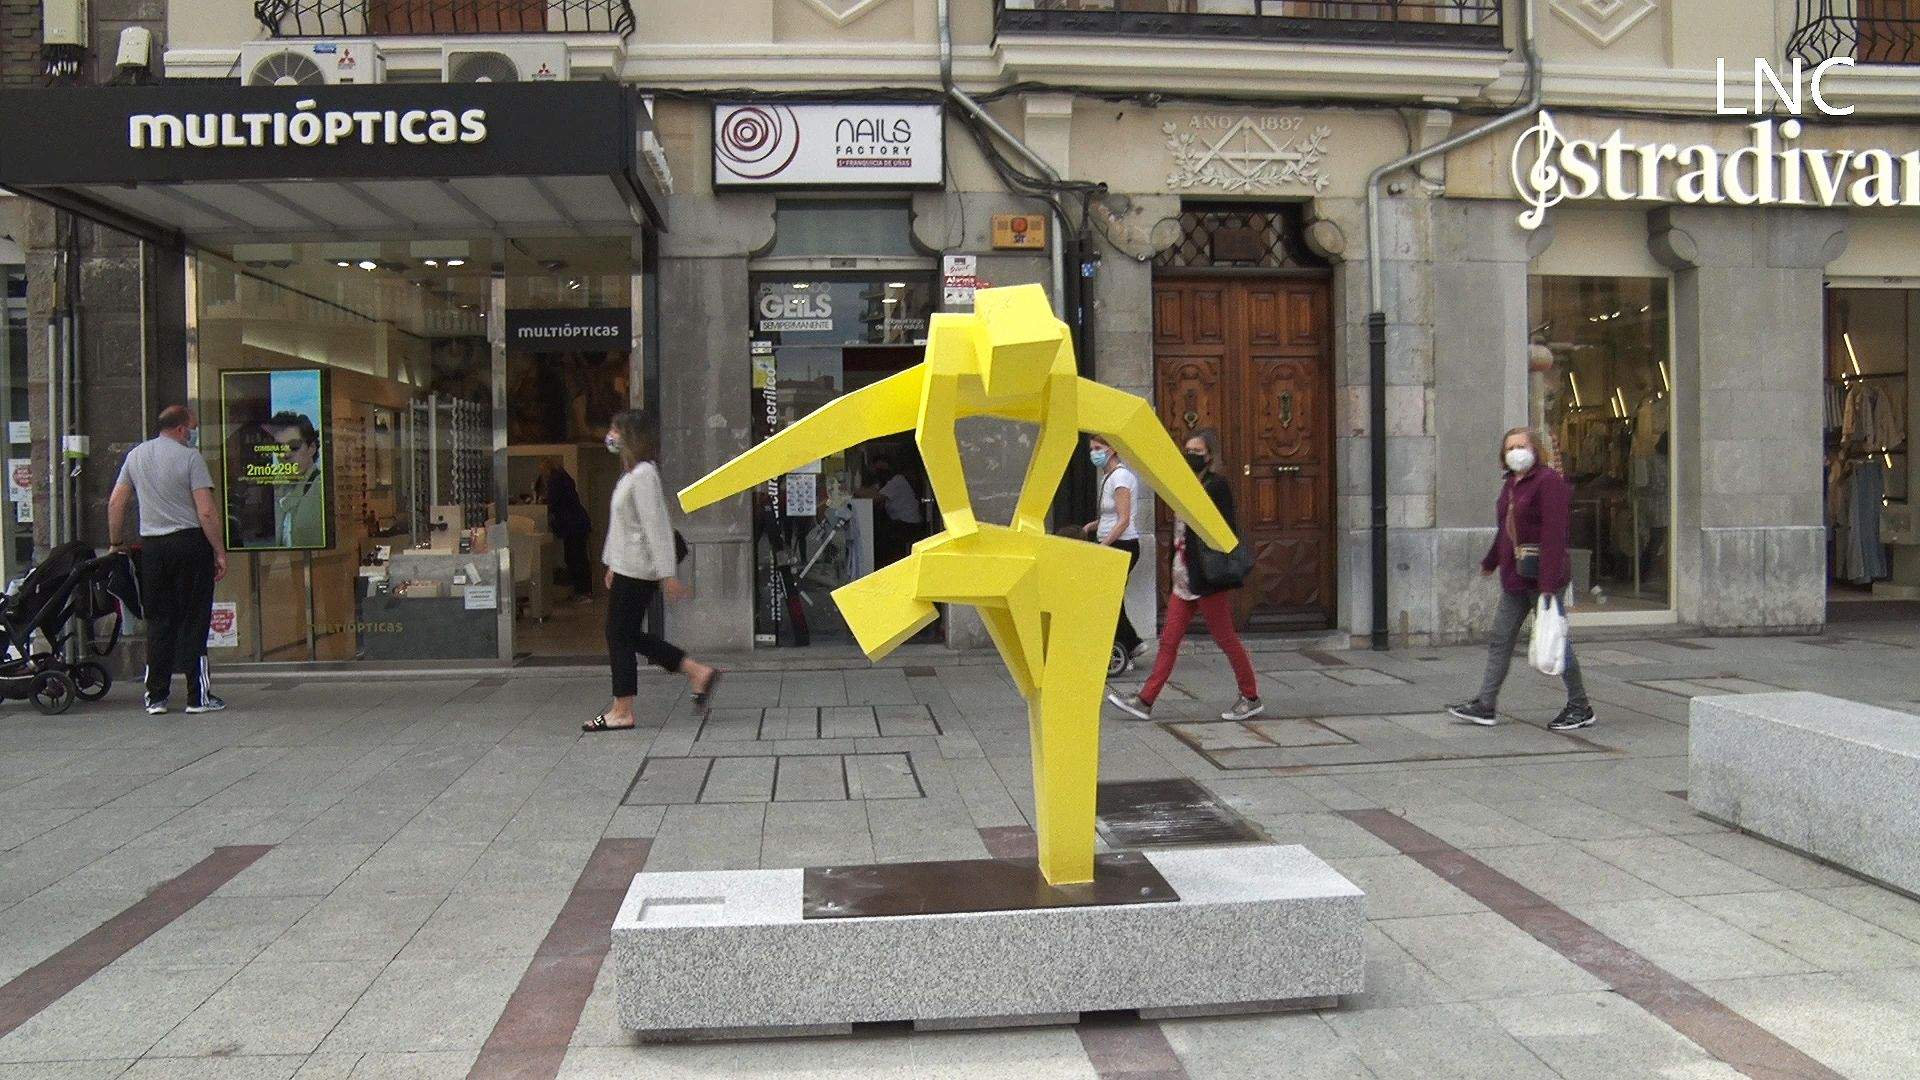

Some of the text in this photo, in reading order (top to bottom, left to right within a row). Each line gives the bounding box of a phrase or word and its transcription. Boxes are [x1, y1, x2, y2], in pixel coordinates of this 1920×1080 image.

[835, 118, 911, 143] NAILS
[836, 145, 911, 155] FACTORY
[763, 369, 778, 425] acrílico
